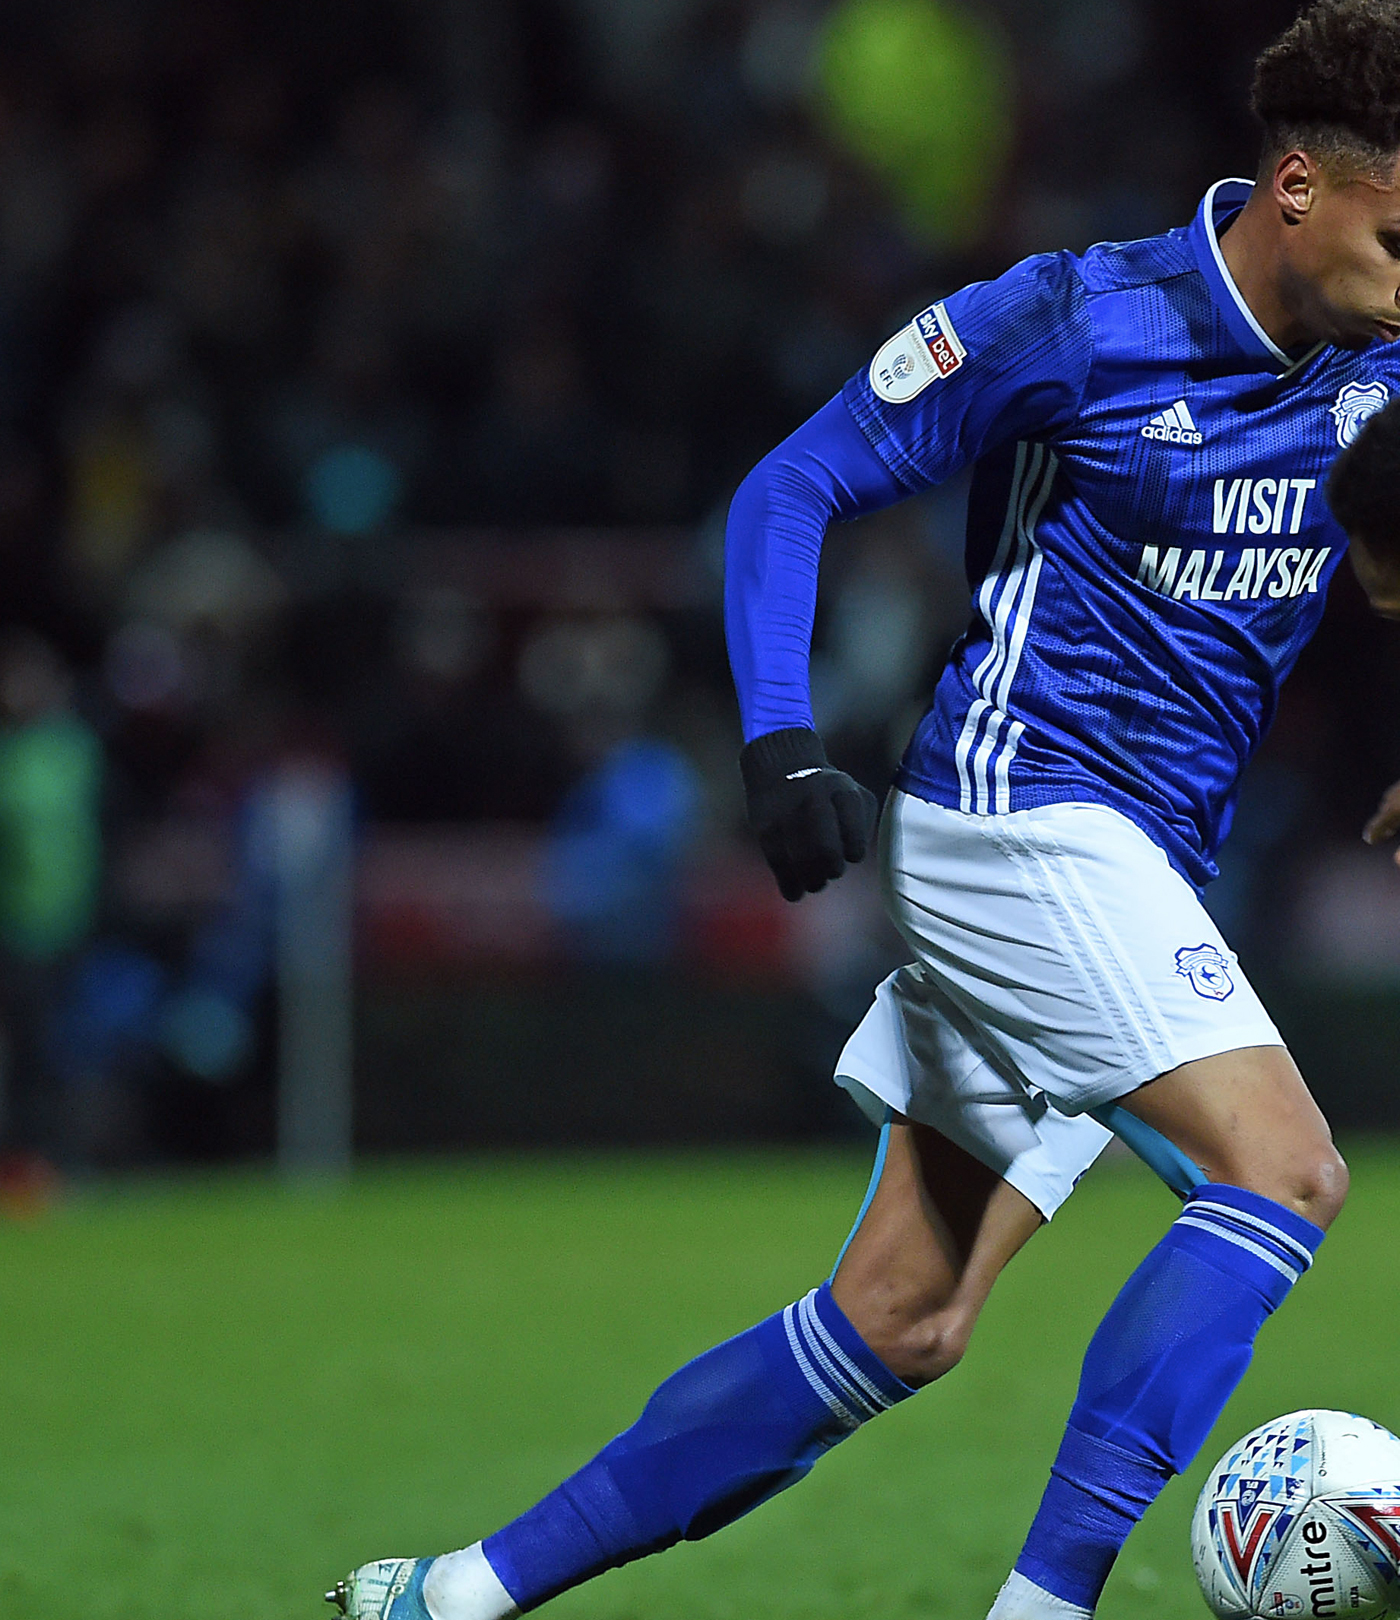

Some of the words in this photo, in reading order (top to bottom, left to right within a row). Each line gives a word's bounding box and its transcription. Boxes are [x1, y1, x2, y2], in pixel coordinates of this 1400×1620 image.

[919, 313, 939, 339] sky
[932, 337, 955, 370] bet
[879, 368, 894, 390] EFL
[1141, 425, 1203, 445] adidas
[1213, 478, 1316, 535] VISIT
[1136, 545, 1332, 601] MALAYSIA
[1300, 1520, 1336, 1618] mitre
